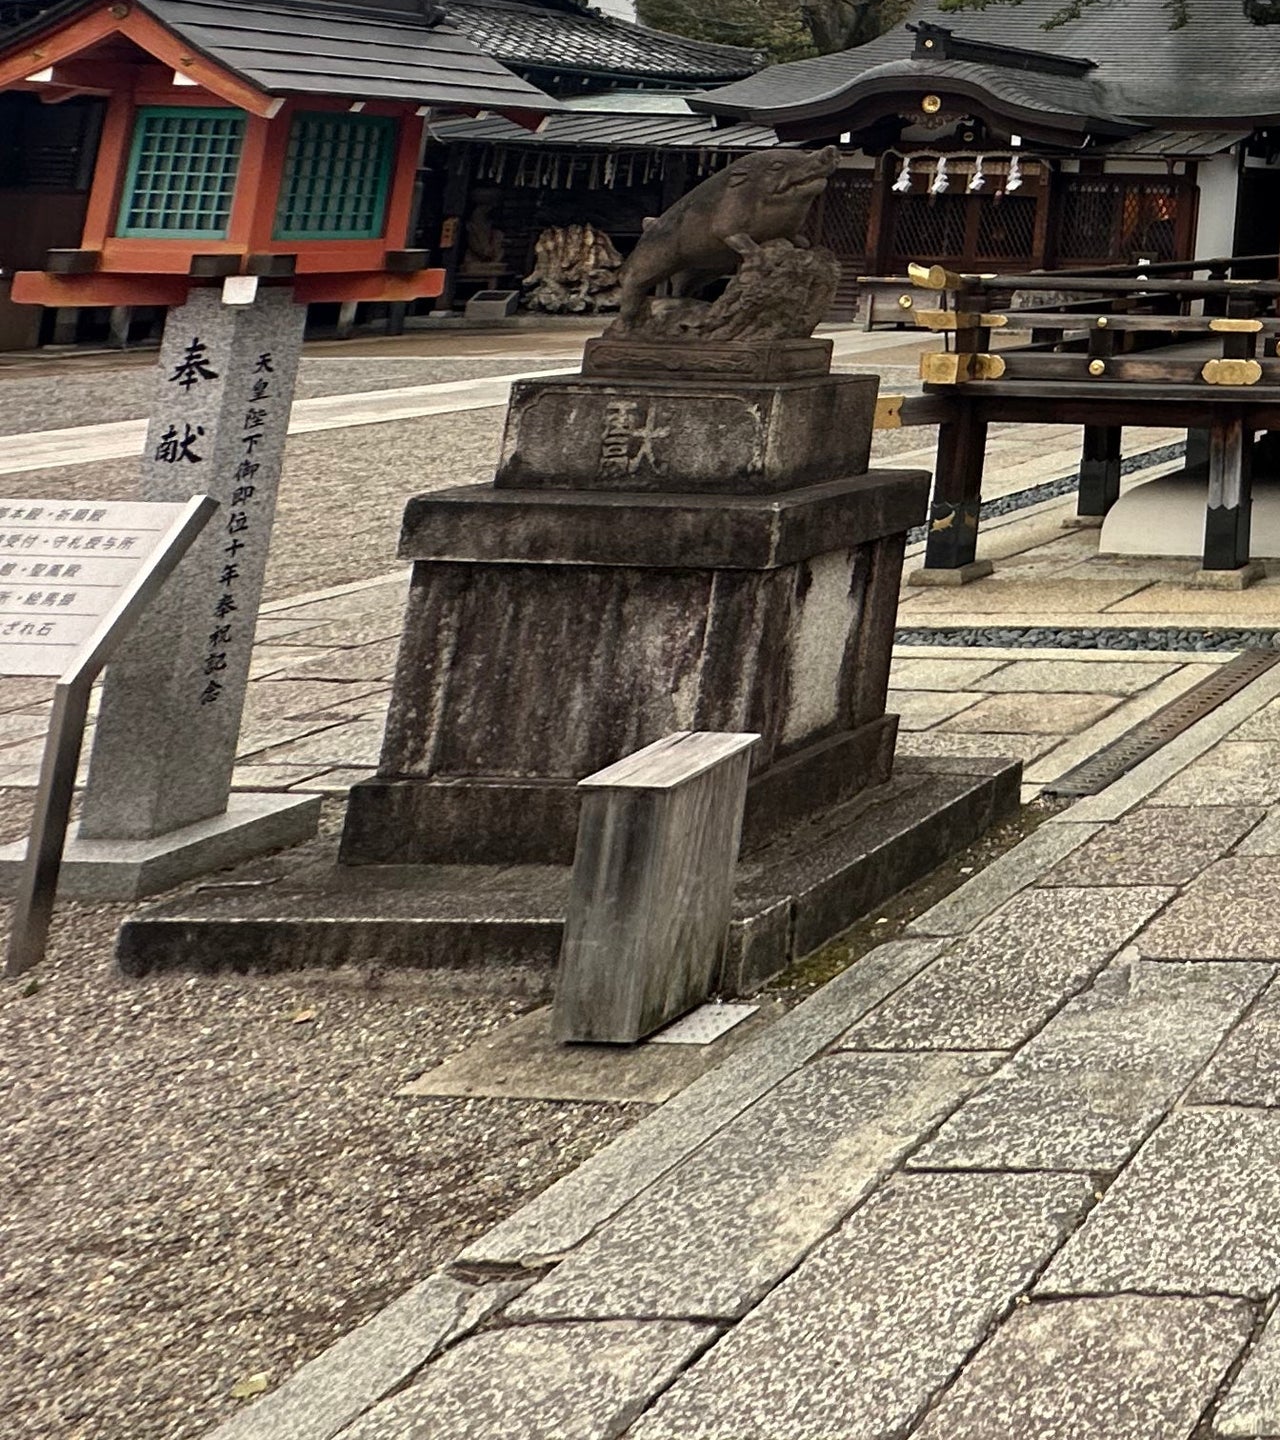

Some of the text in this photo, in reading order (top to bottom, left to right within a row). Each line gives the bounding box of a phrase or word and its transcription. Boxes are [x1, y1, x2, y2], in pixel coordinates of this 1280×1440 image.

[155, 336, 219, 464] 奉献
[201, 353, 274, 706] 天皇陛下御即位十年奉祝記念
[0, 621, 56, 636] ざれ石
